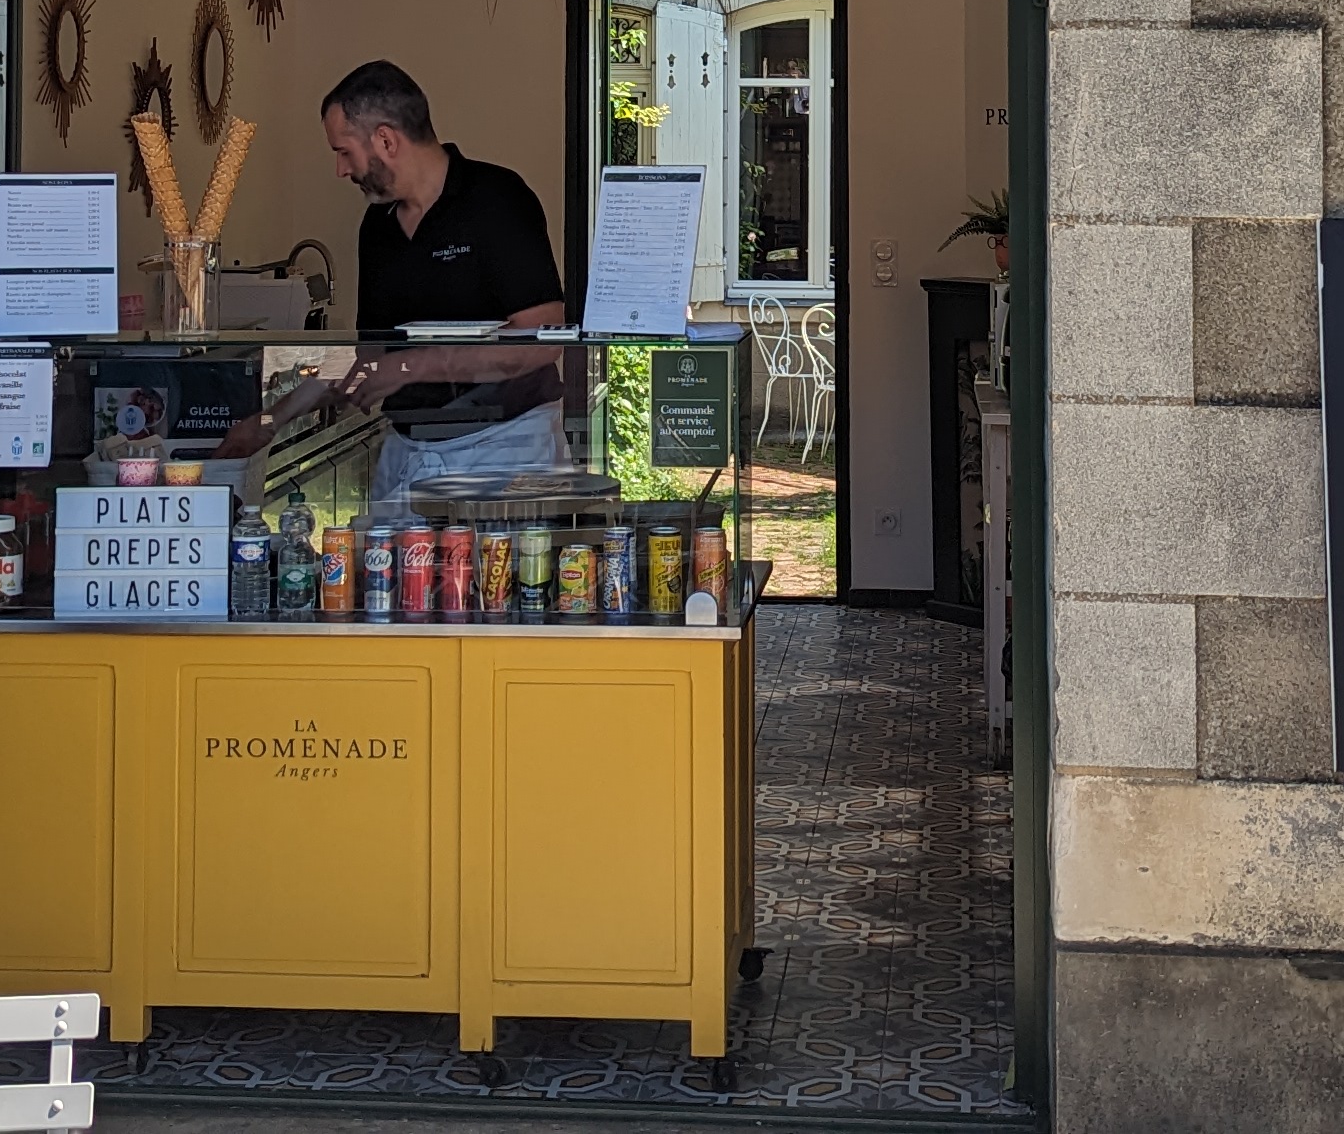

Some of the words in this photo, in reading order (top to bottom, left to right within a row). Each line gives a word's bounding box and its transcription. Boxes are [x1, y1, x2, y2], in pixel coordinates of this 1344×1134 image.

[189, 406, 230, 417] GLACES
[660, 404, 715, 415] Commande
[677, 416, 709, 426] service
[673, 426, 716, 439] comptoir
[96, 496, 191, 524] PLATS
[87, 537, 202, 566] CREPES
[486, 541, 509, 601] CACOLAC
[86, 580, 201, 608] GLACES
[294, 720, 318, 733] LA
[205, 737, 408, 759] PROMENADE
[274, 764, 338, 781] Angers
